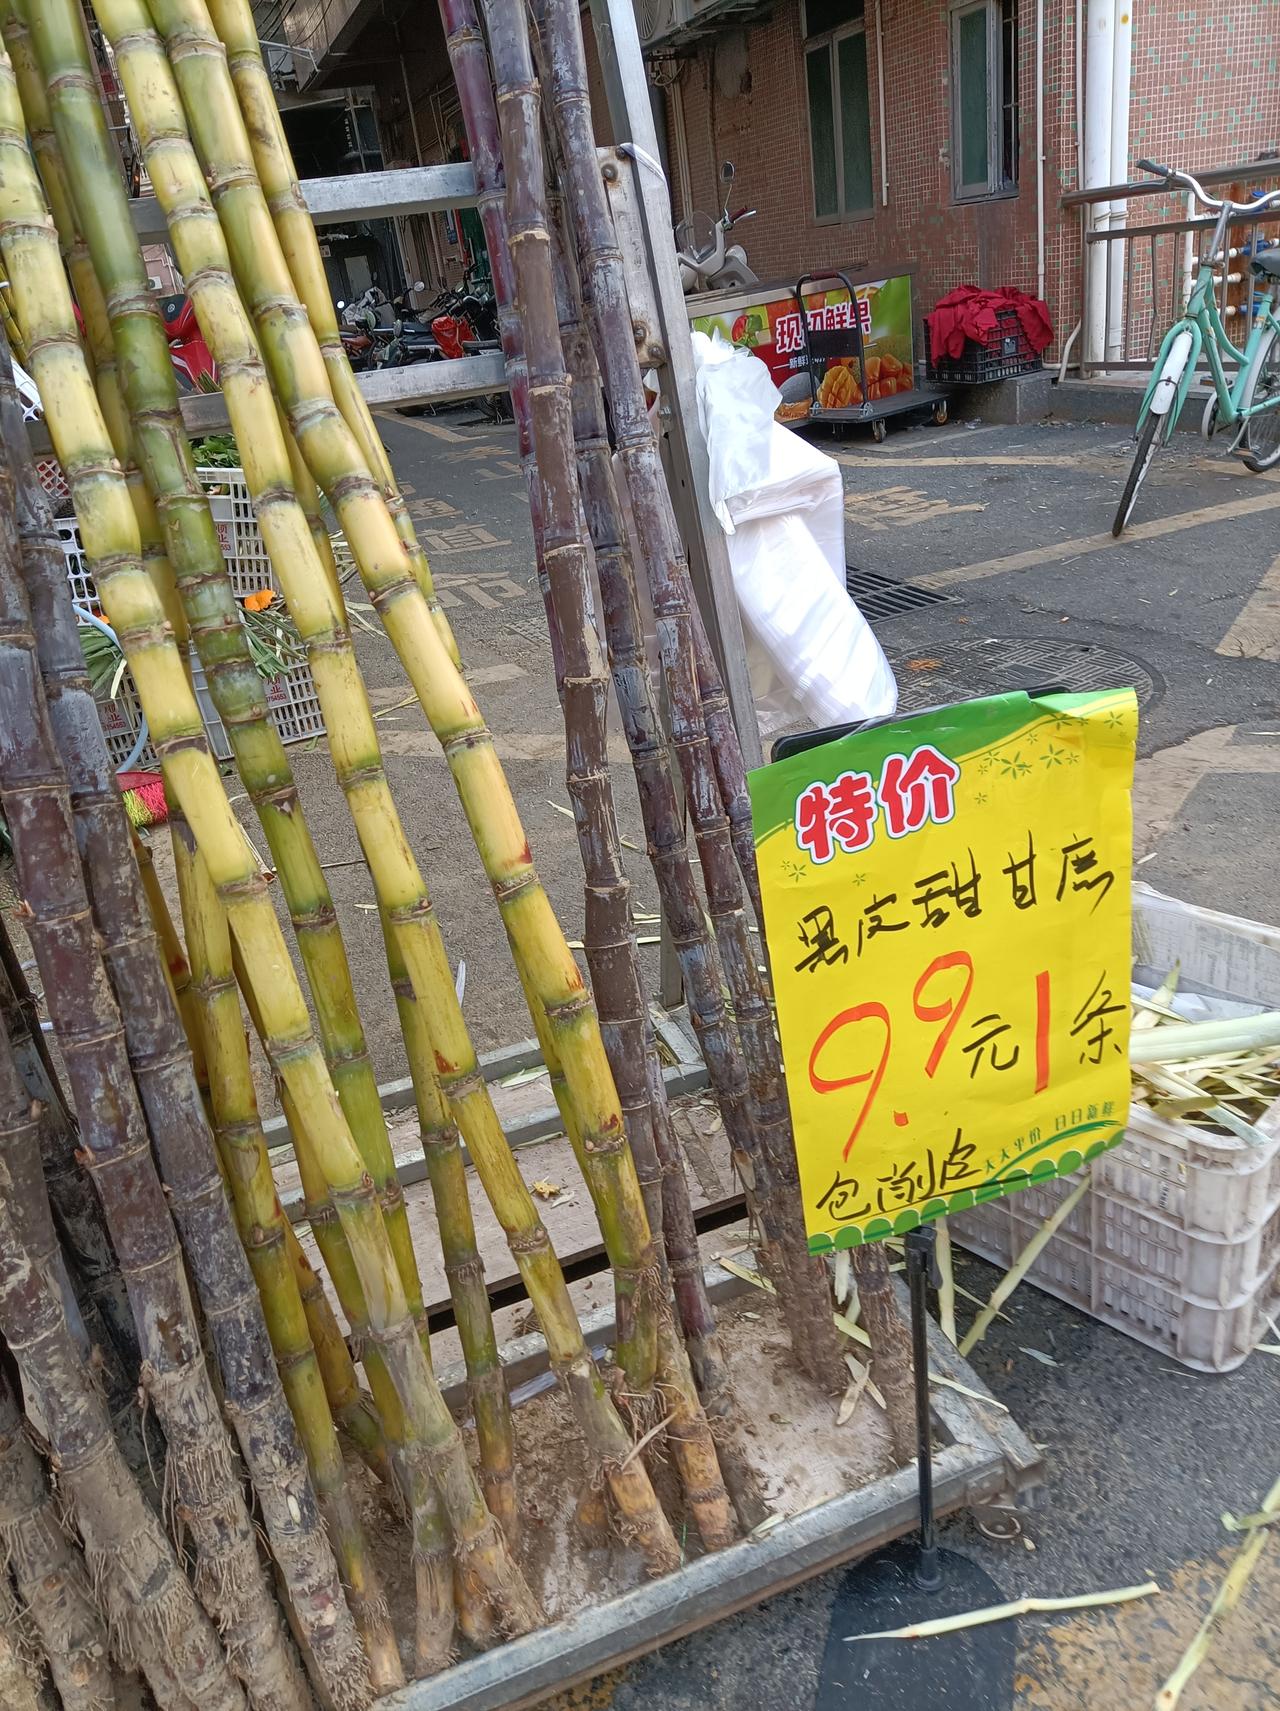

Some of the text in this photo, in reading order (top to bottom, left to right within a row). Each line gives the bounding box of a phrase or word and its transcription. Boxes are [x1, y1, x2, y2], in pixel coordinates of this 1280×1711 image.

[797, 744, 960, 864] 特价
[815, 1128, 985, 1221] 包削皮
